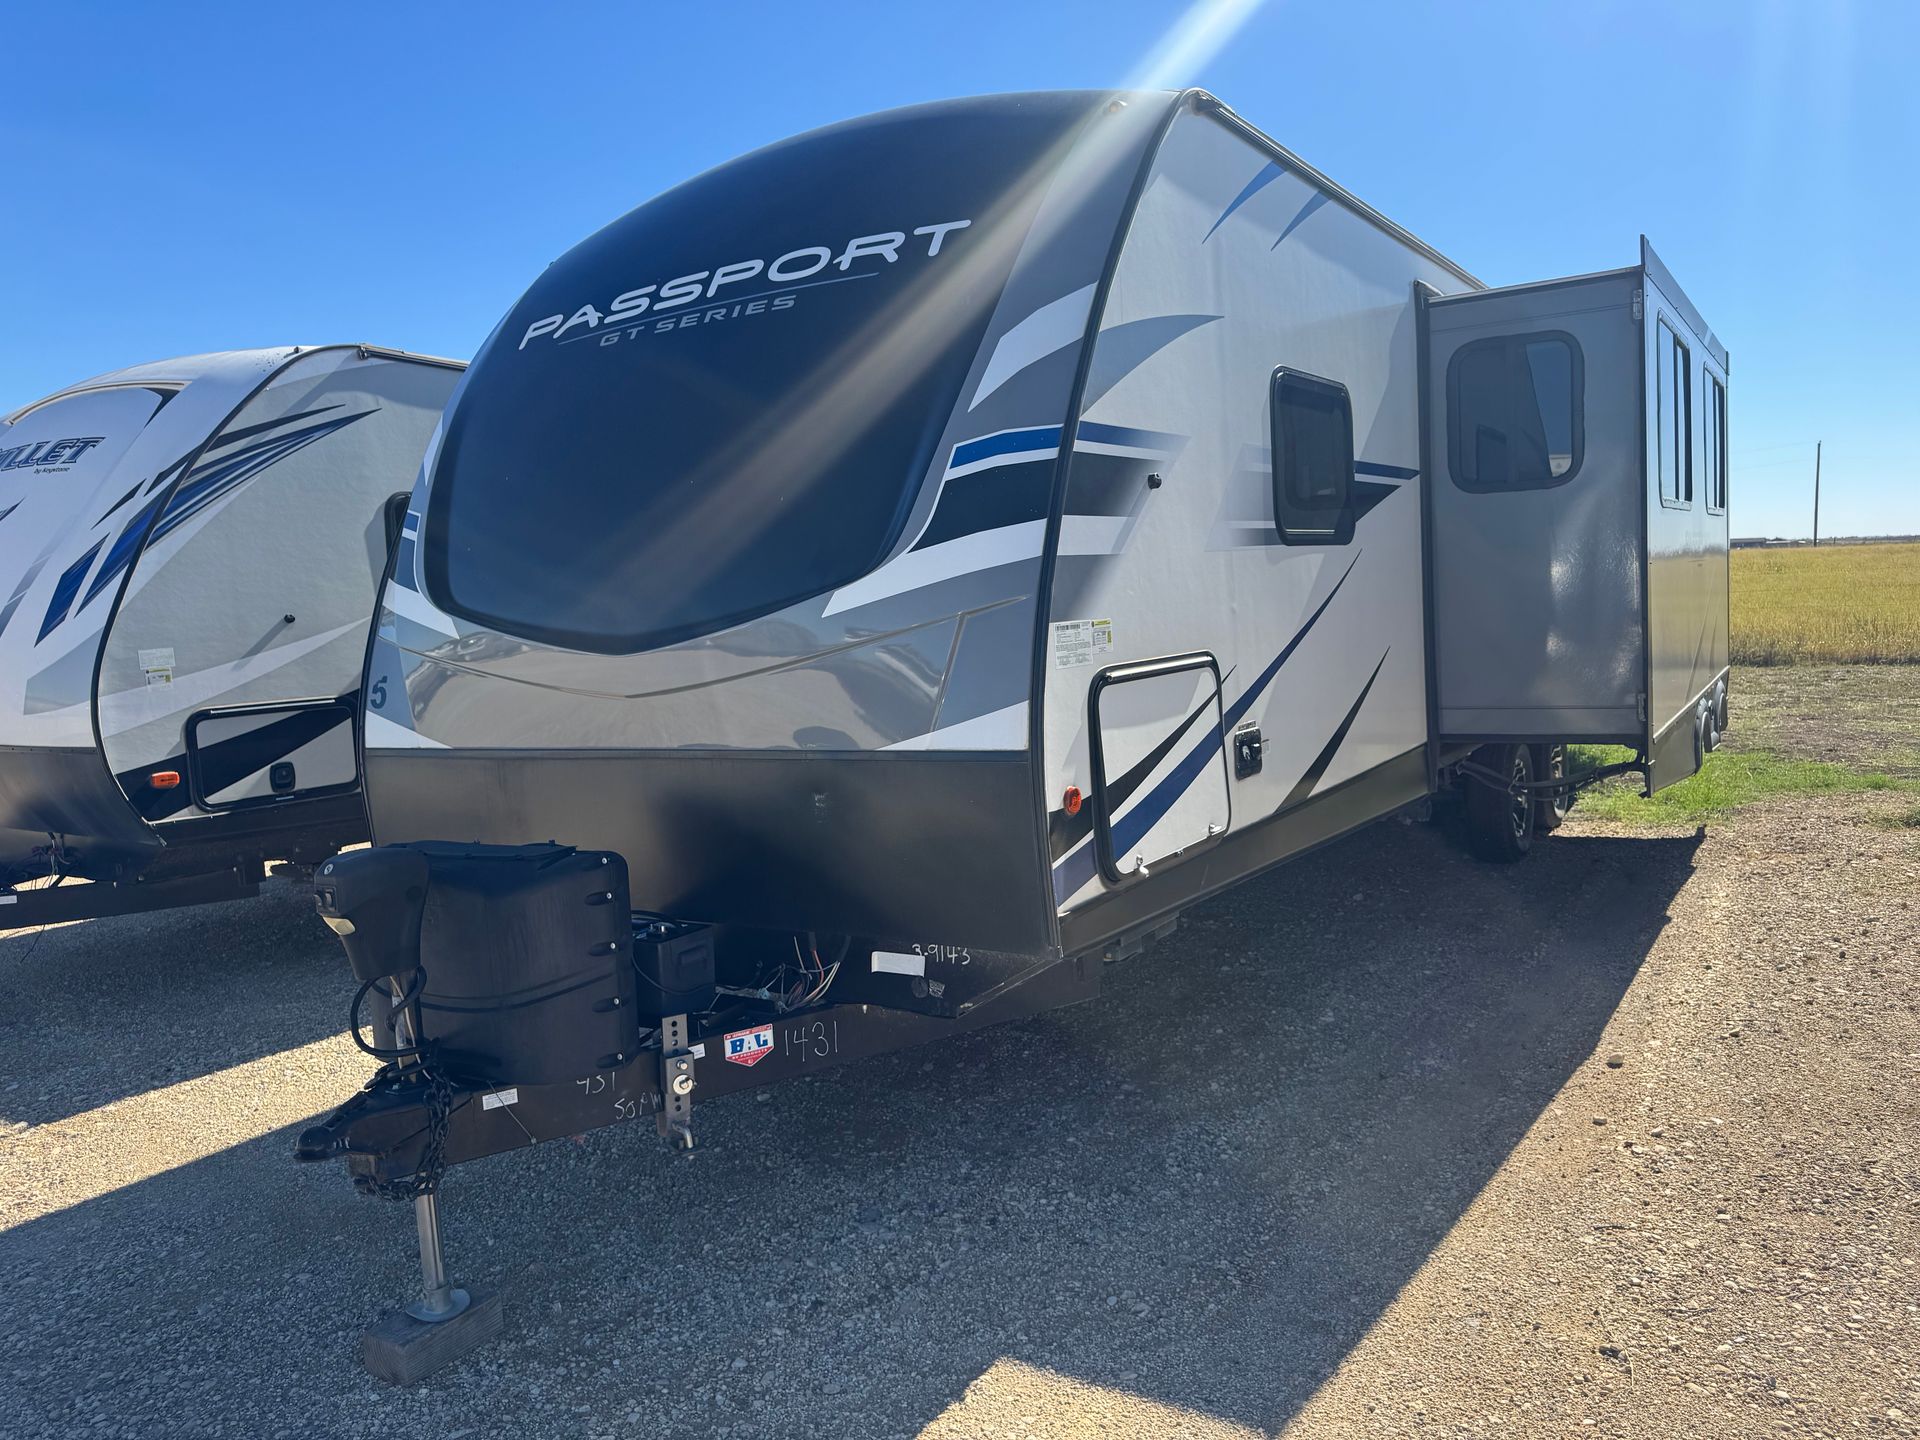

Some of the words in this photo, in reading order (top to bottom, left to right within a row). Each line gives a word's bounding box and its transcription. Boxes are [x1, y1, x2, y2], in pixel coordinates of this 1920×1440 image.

[518, 218, 972, 351] PASSPORT
[599, 325, 645, 347] GT
[654, 294, 797, 334] SERIES
[370, 675, 388, 709] 5
[784, 1020, 838, 1062] 1431
